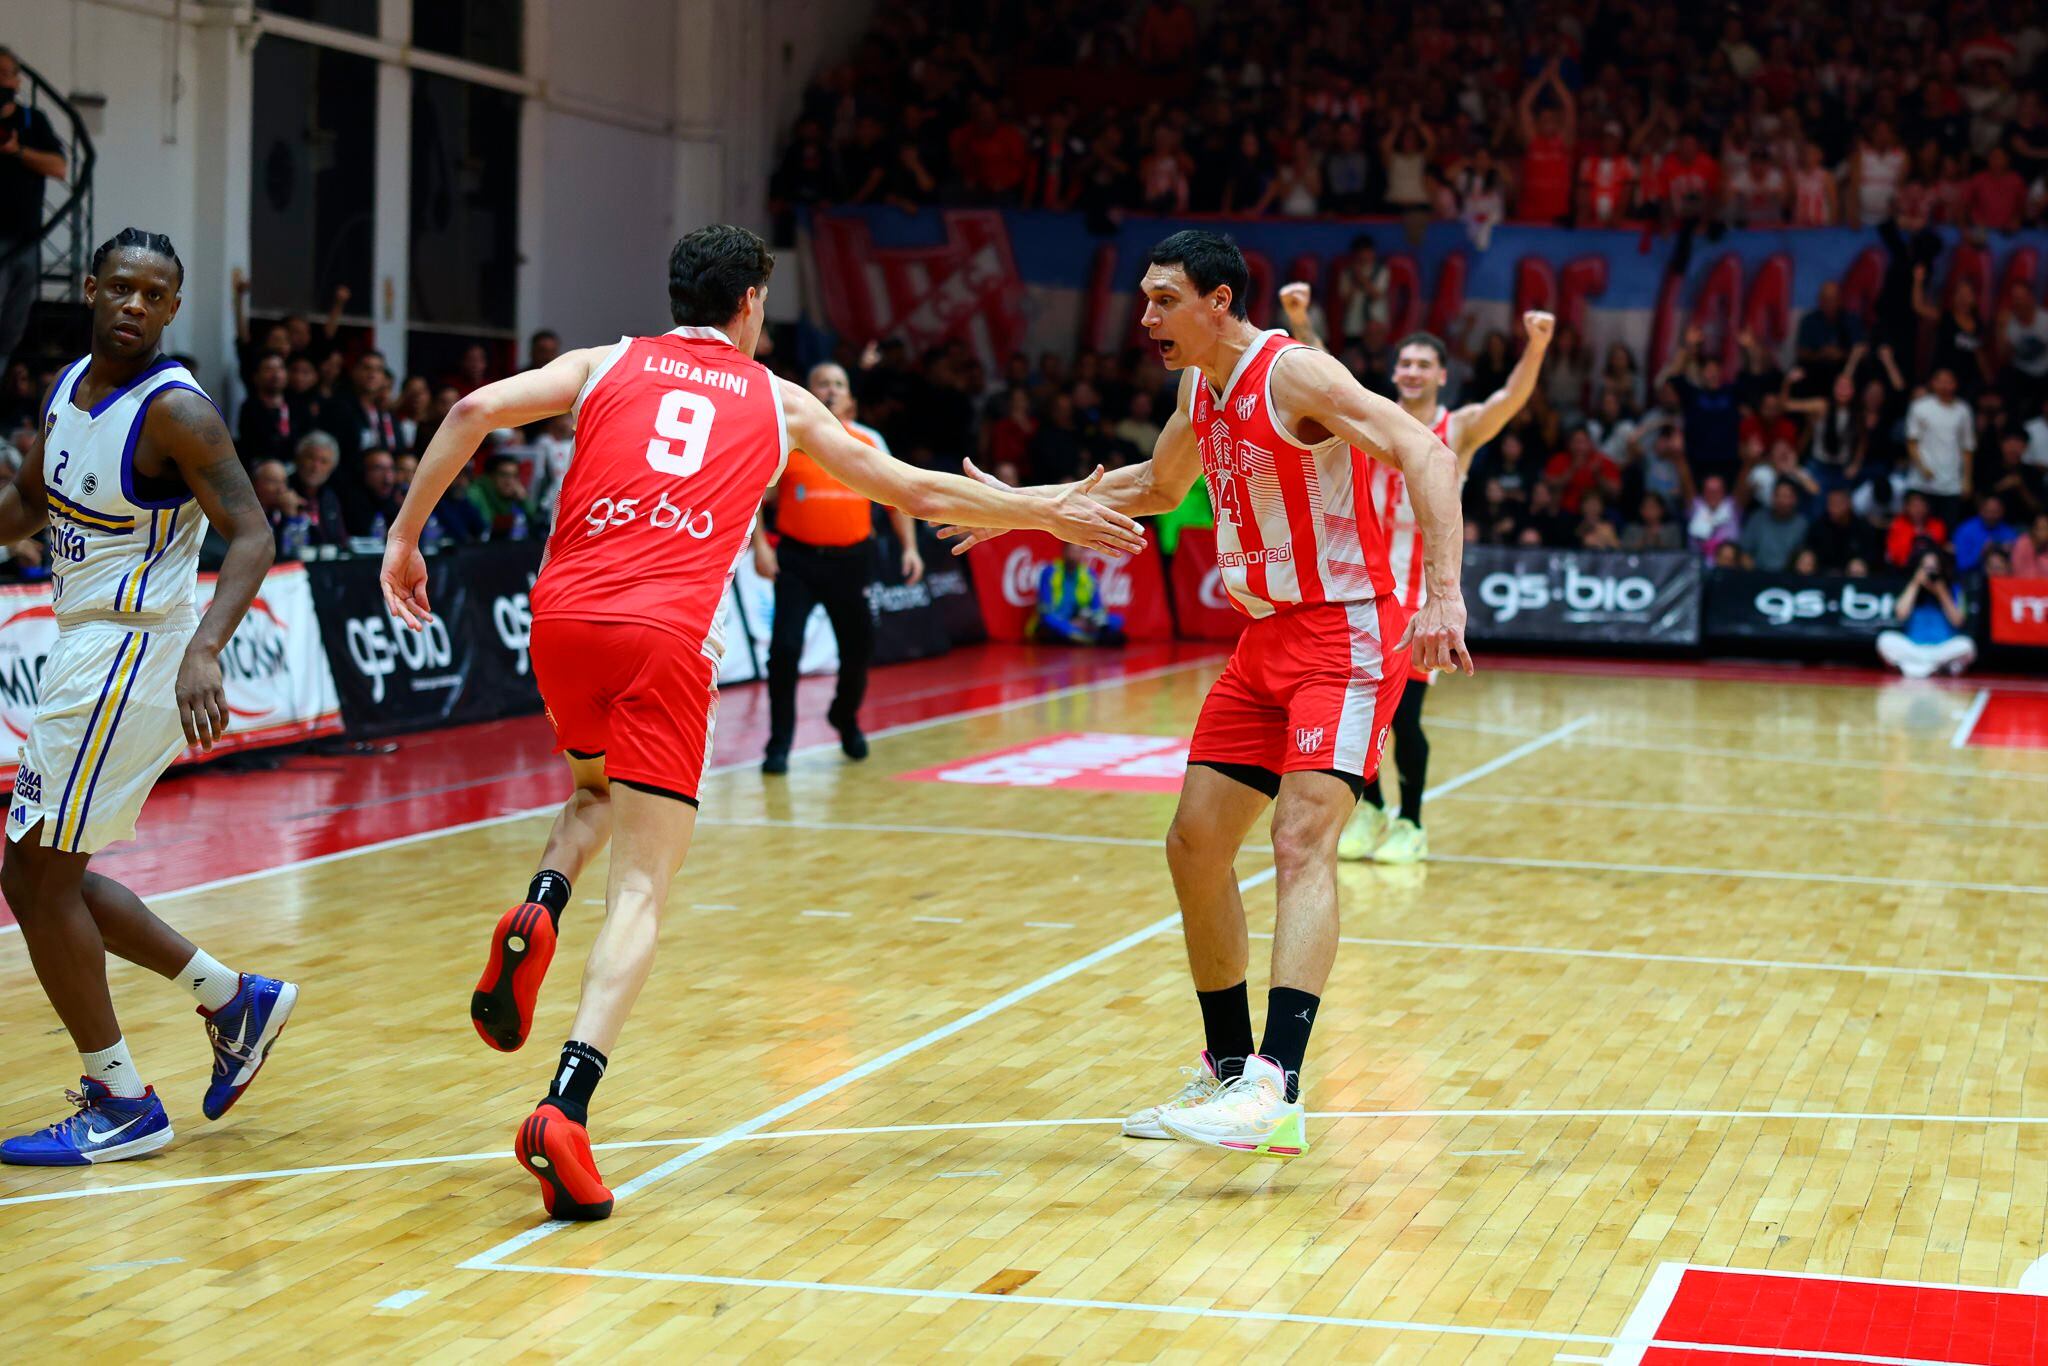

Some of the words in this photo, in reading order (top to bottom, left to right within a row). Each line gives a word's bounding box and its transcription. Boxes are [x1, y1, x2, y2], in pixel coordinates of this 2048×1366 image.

[643, 355, 749, 398] LUGARINI
[645, 388, 717, 478] 9
[53, 450, 70, 486] 2
[1217, 542, 1293, 569] ecnored
[18, 765, 42, 789] OMA
